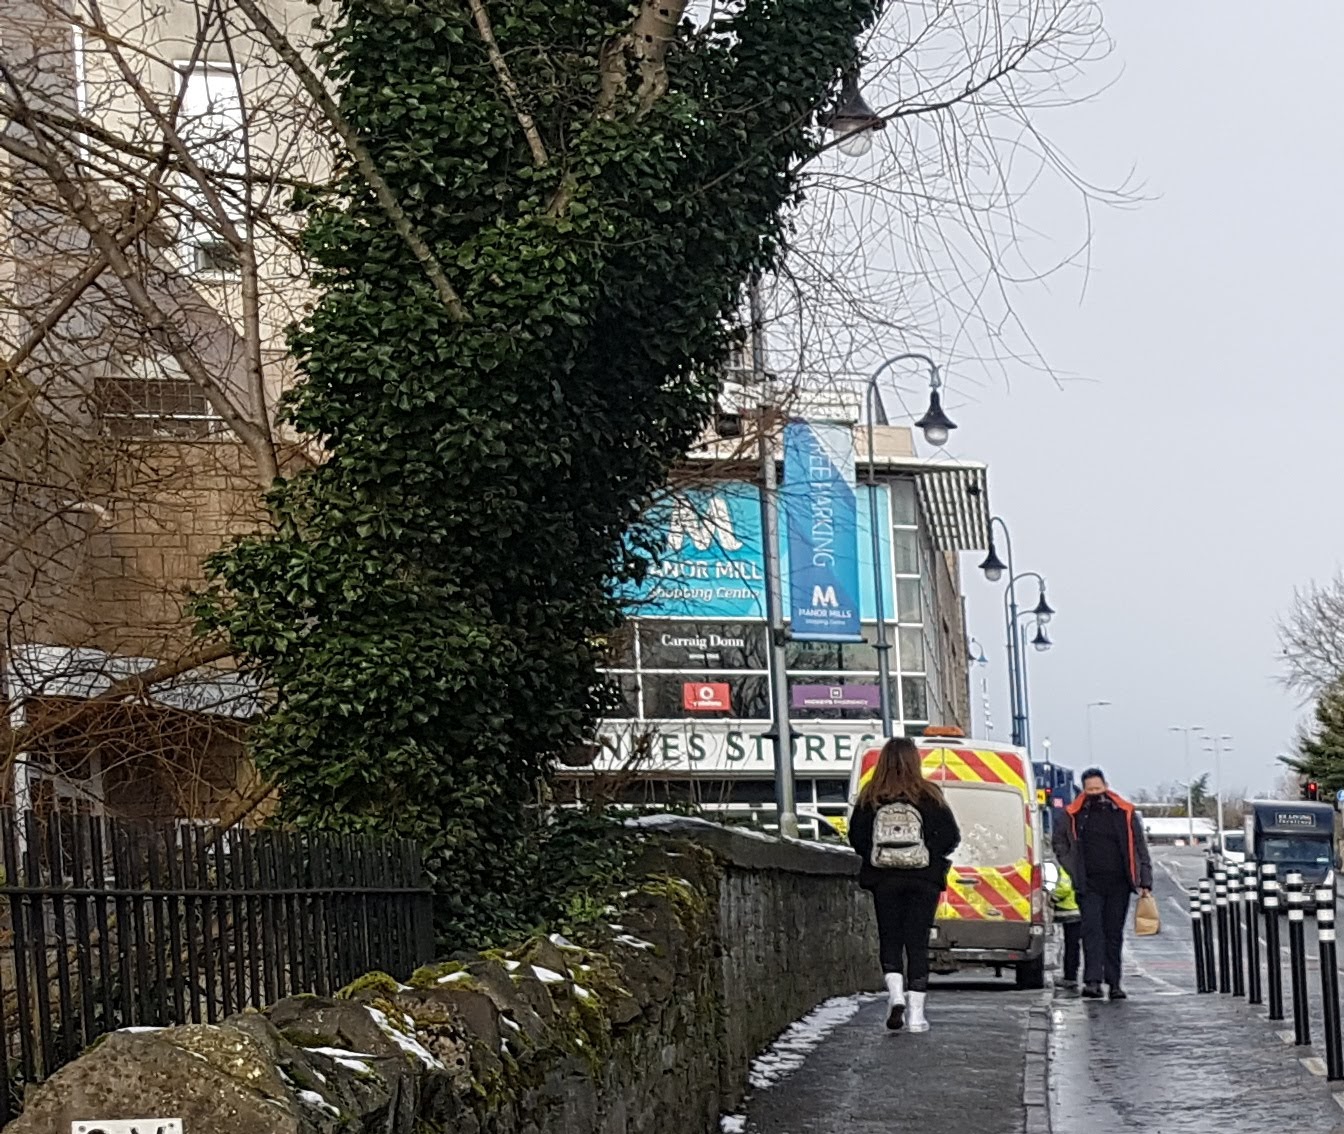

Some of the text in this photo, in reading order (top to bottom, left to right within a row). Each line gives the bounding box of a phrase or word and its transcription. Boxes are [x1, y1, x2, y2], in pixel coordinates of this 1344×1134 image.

[809, 431, 831, 479] REE
[647, 560, 709, 578] ANOR
[661, 633, 744, 651] Carraig Donn
[726, 731, 875, 761] STRE
